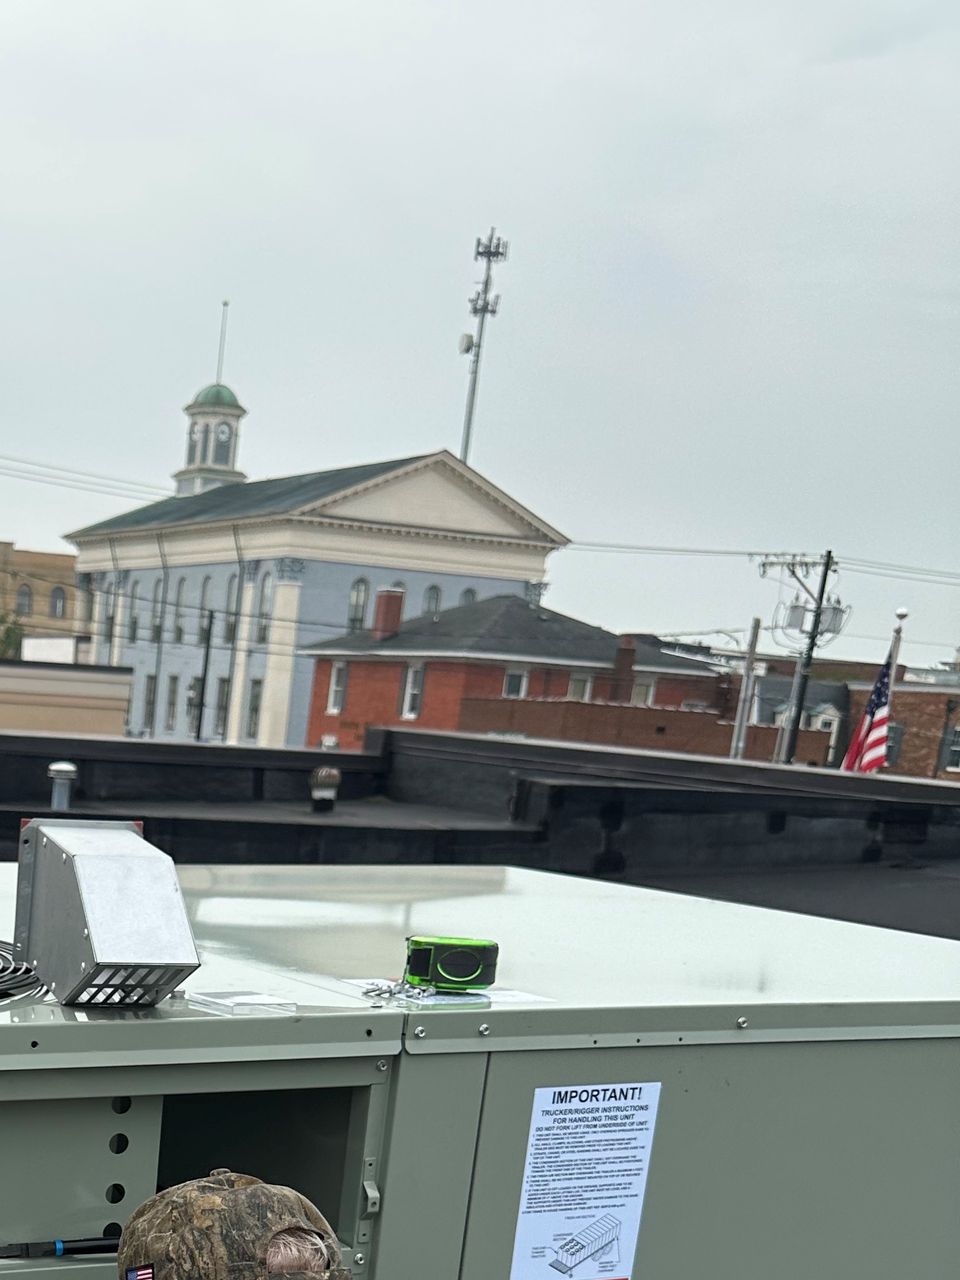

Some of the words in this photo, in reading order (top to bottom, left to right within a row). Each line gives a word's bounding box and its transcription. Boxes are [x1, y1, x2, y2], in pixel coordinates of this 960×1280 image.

[551, 1086, 643, 1105] IMPORTANT!
[541, 1107, 600, 1117] TRUCKER/RIGGER
[601, 1104, 649, 1113] INSTRUCTIONS
[552, 1117, 567, 1125] FOR
[568, 1115, 602, 1124] HANDLING
[604, 1114, 619, 1122] THIS
[620, 1113, 635, 1121] UNIT
